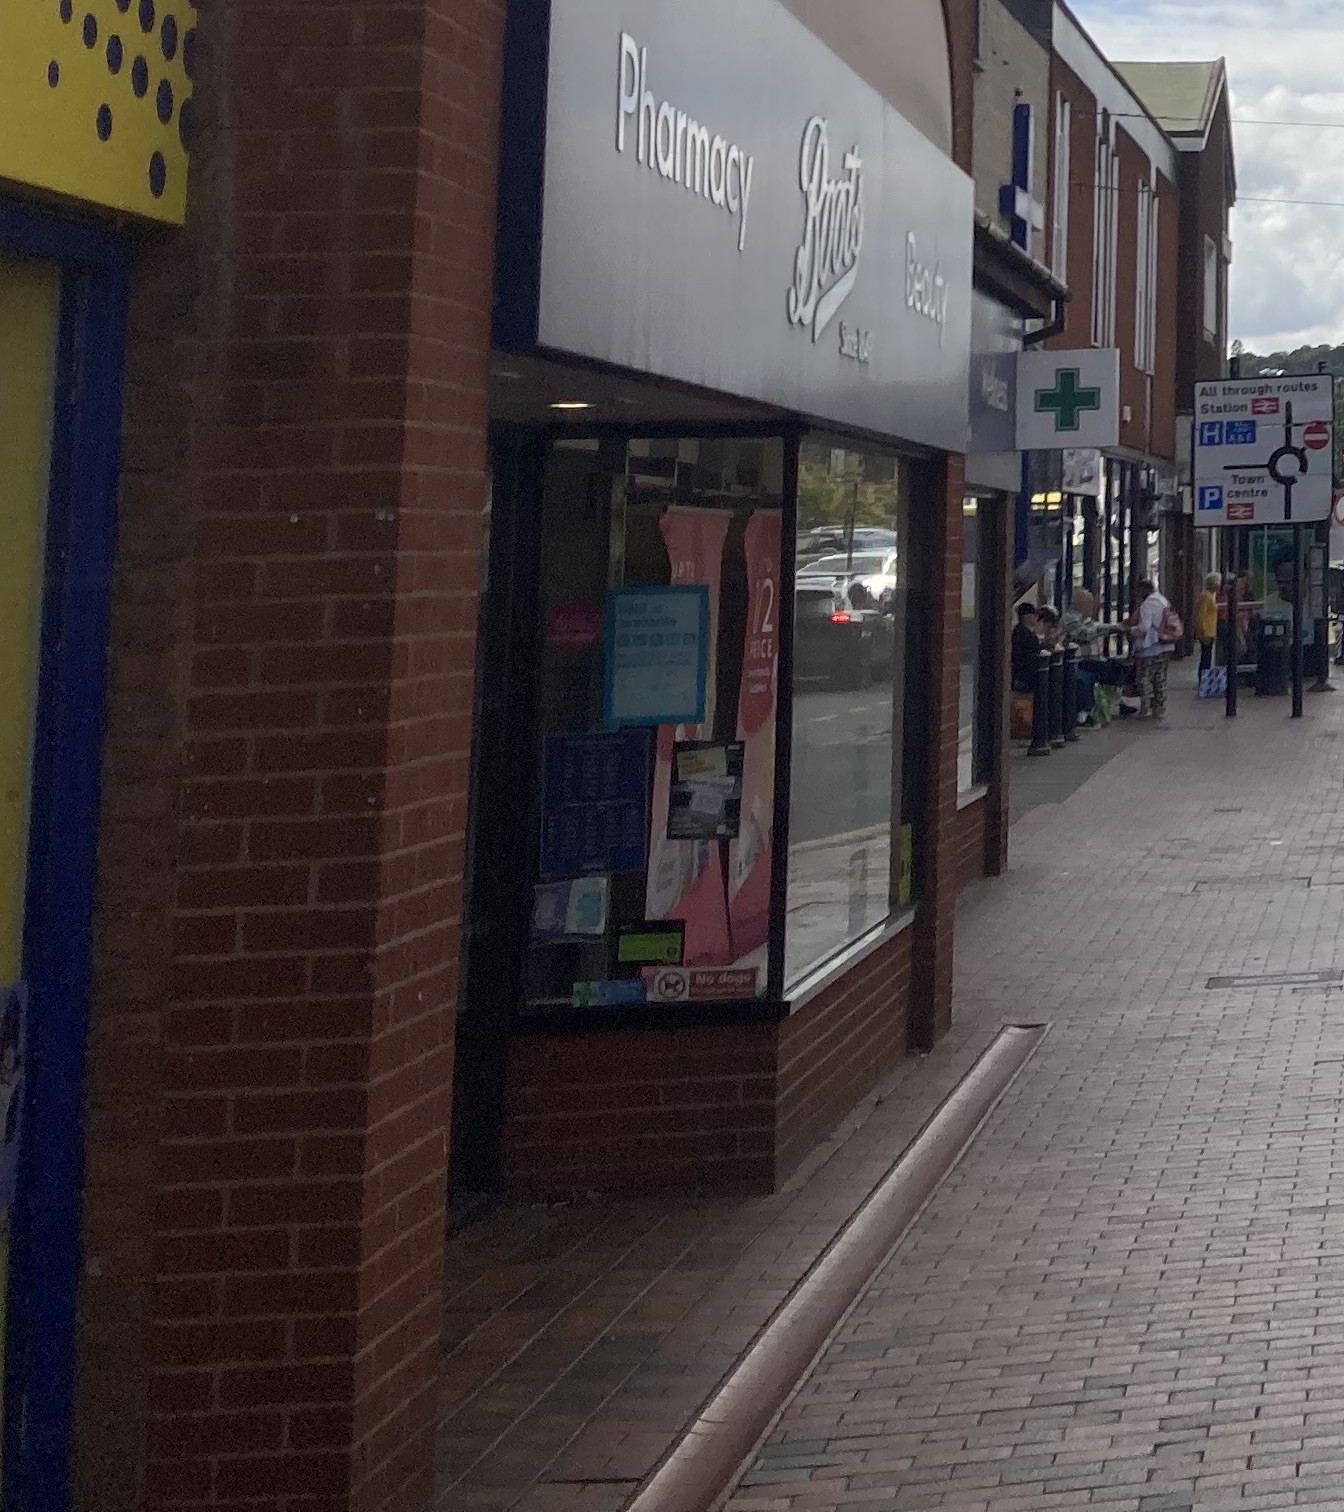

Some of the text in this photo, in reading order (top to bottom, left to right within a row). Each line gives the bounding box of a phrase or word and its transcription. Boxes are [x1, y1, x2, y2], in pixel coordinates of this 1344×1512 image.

[615, 31, 753, 252] Pharmacy
[786, 115, 864, 343] Boots
[1200, 381, 1318, 397] All through routes
[1200, 402, 1248, 415] Station
[1202, 423, 1221, 443] H
[1231, 474, 1265, 484] Town
[1204, 488, 1221, 509] P
[1226, 488, 1268, 499] centre
[695, 972, 752, 987] No dogs
